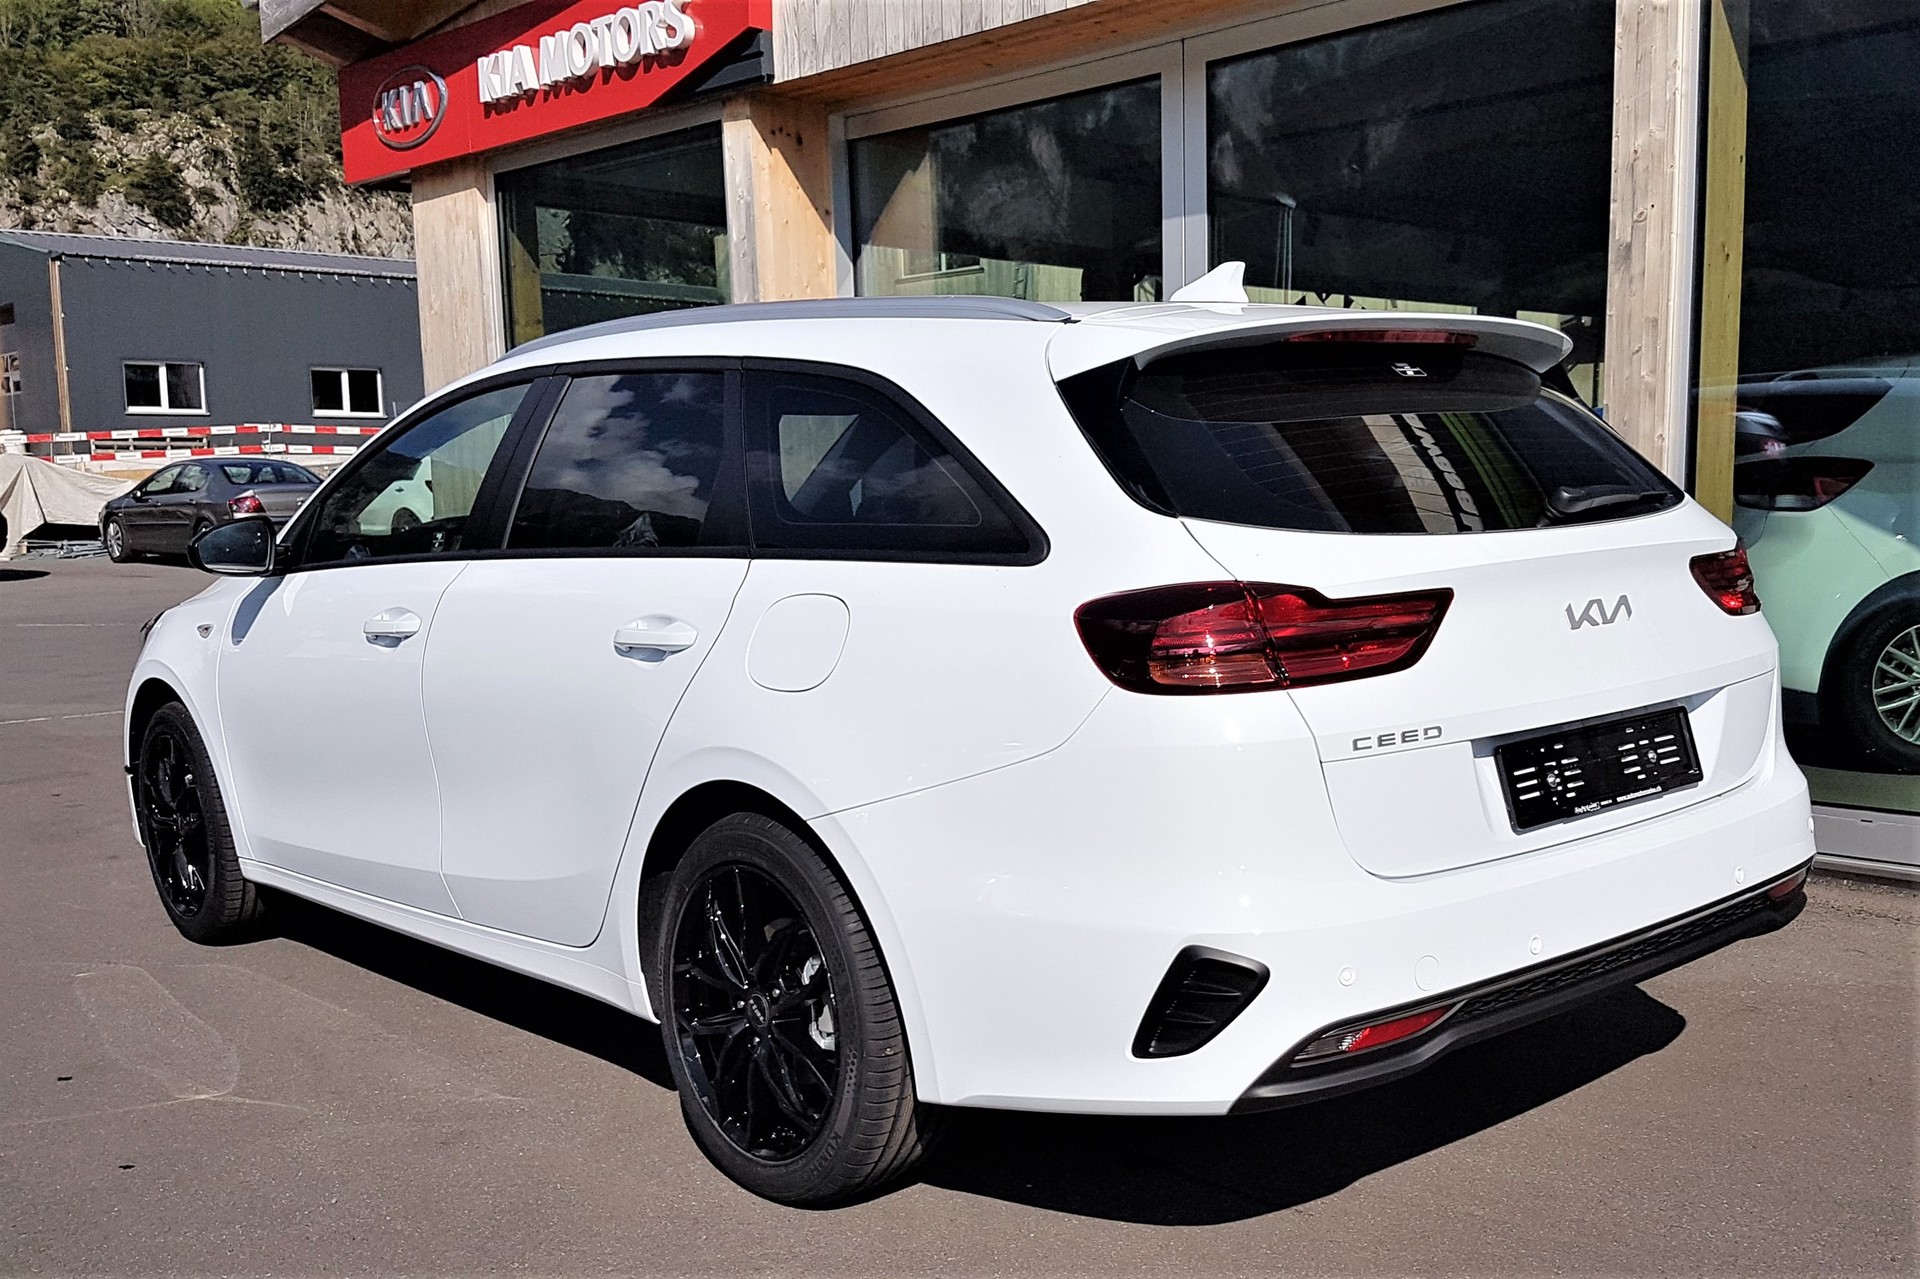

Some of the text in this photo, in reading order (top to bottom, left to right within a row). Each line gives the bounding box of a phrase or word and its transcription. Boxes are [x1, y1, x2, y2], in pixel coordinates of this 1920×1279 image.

[477, 0, 694, 103] KIA MOTORS
[381, 80, 434, 131] KIA
[1565, 595, 1632, 630] KIA
[1352, 725, 1442, 752] CEED
